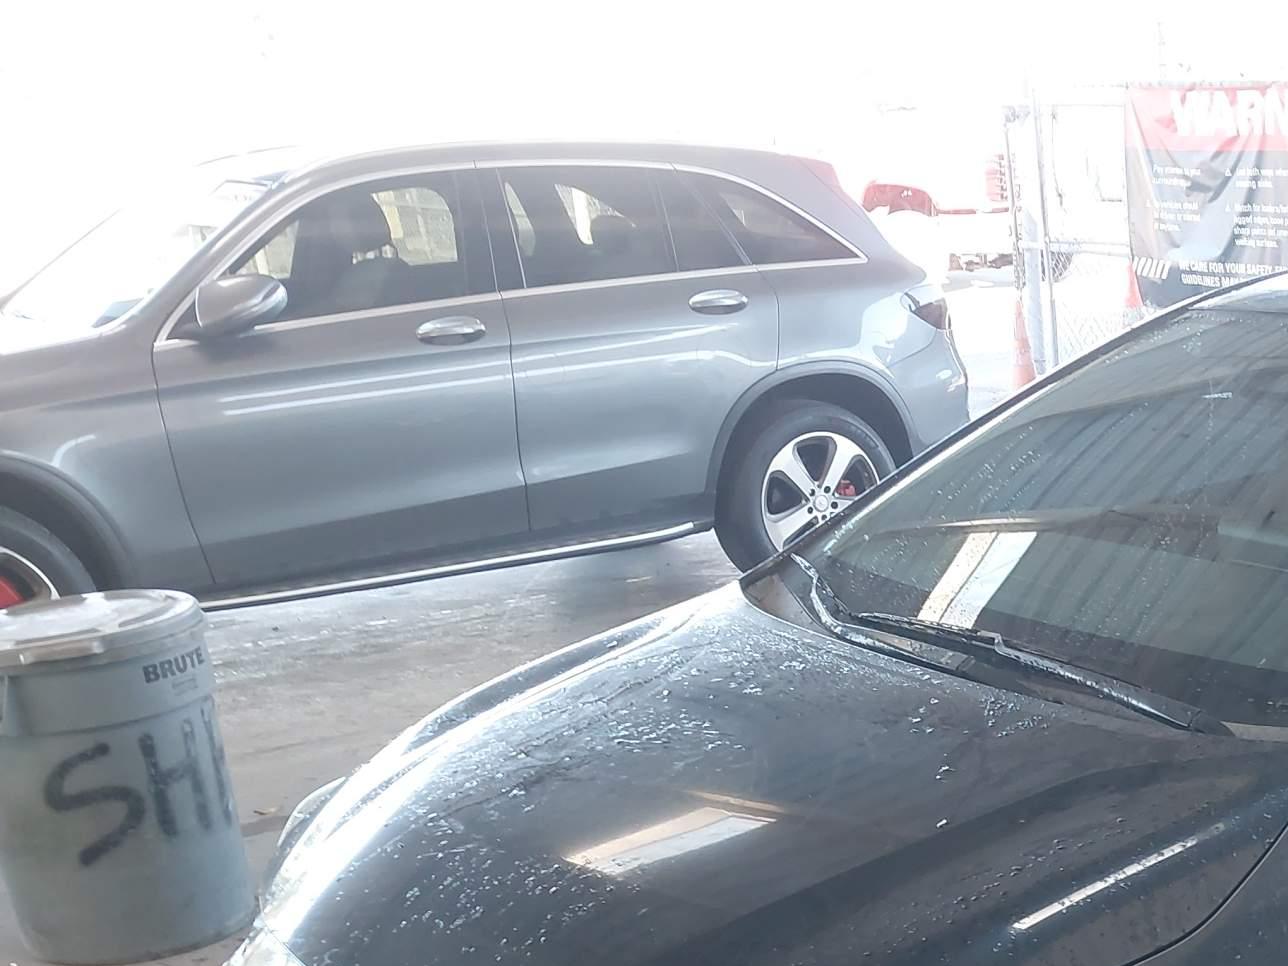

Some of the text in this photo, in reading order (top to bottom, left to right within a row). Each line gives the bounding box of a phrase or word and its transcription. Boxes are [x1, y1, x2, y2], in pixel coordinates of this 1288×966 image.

[1209, 261, 1224, 273] FOR
[1224, 262, 1245, 274] YOUR
[141, 646, 206, 684] BRUTE
